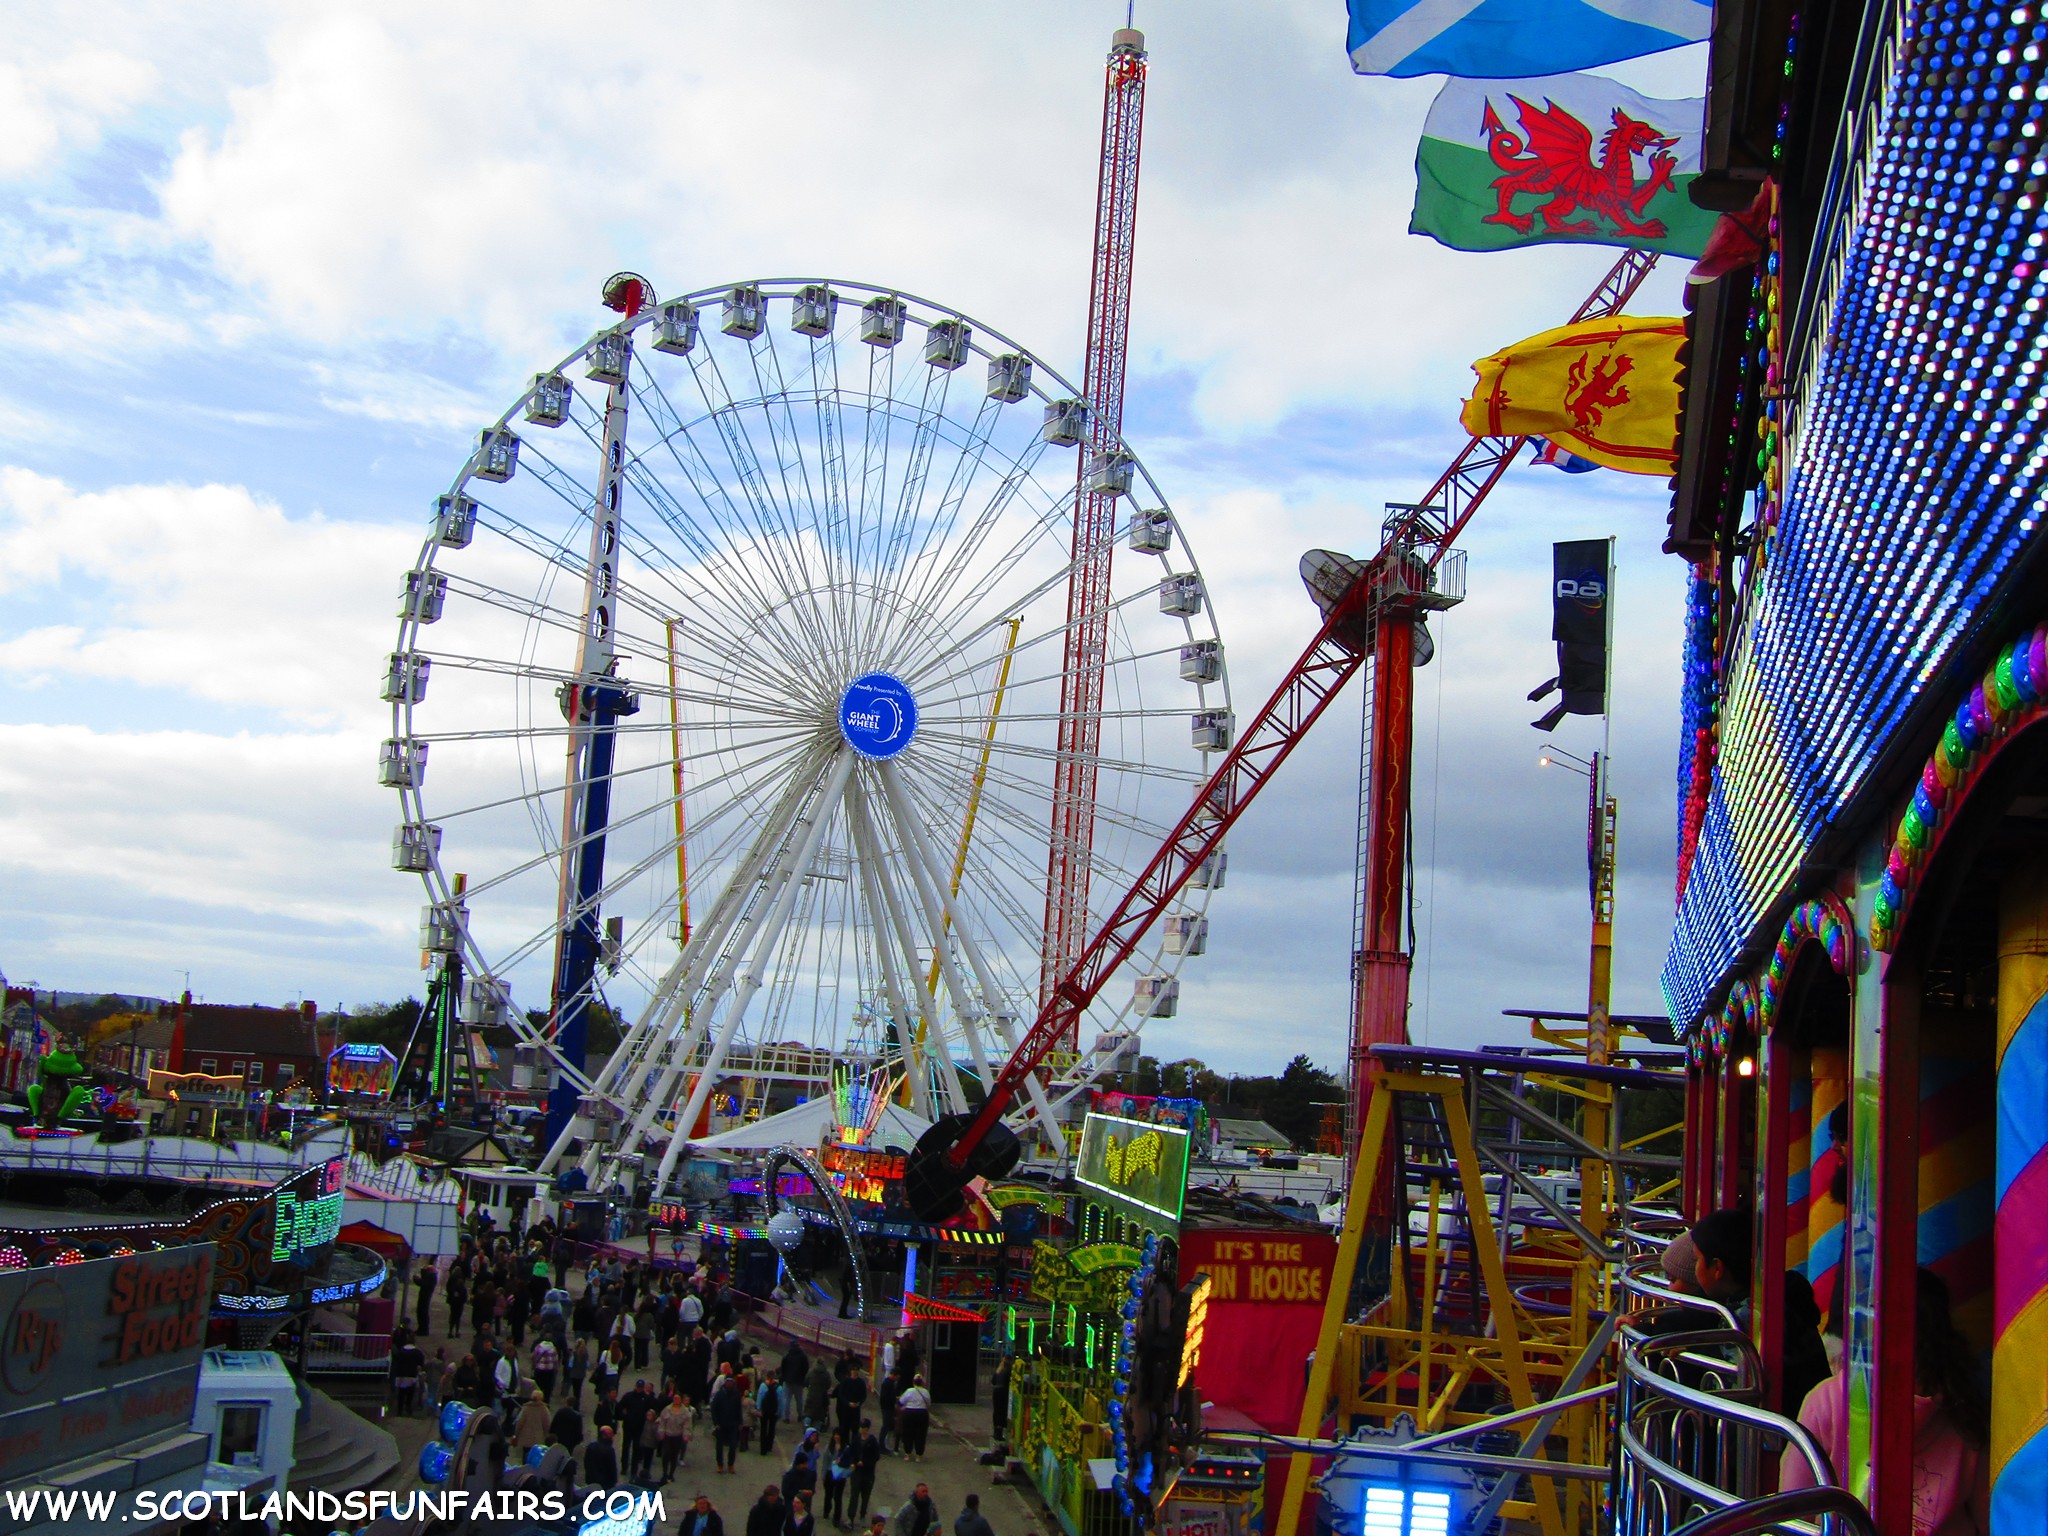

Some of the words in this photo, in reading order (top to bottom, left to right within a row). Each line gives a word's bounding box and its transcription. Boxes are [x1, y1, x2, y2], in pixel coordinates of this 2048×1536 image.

[847, 717, 879, 729] WHEEL
[850, 711, 880, 722] GIANT
[1214, 1241, 1256, 1261] IT'S
[1261, 1242, 1302, 1262] THE
[111, 1252, 211, 1314] Street
[1248, 1264, 1323, 1301] HOUSE
[119, 1301, 203, 1362] Food
